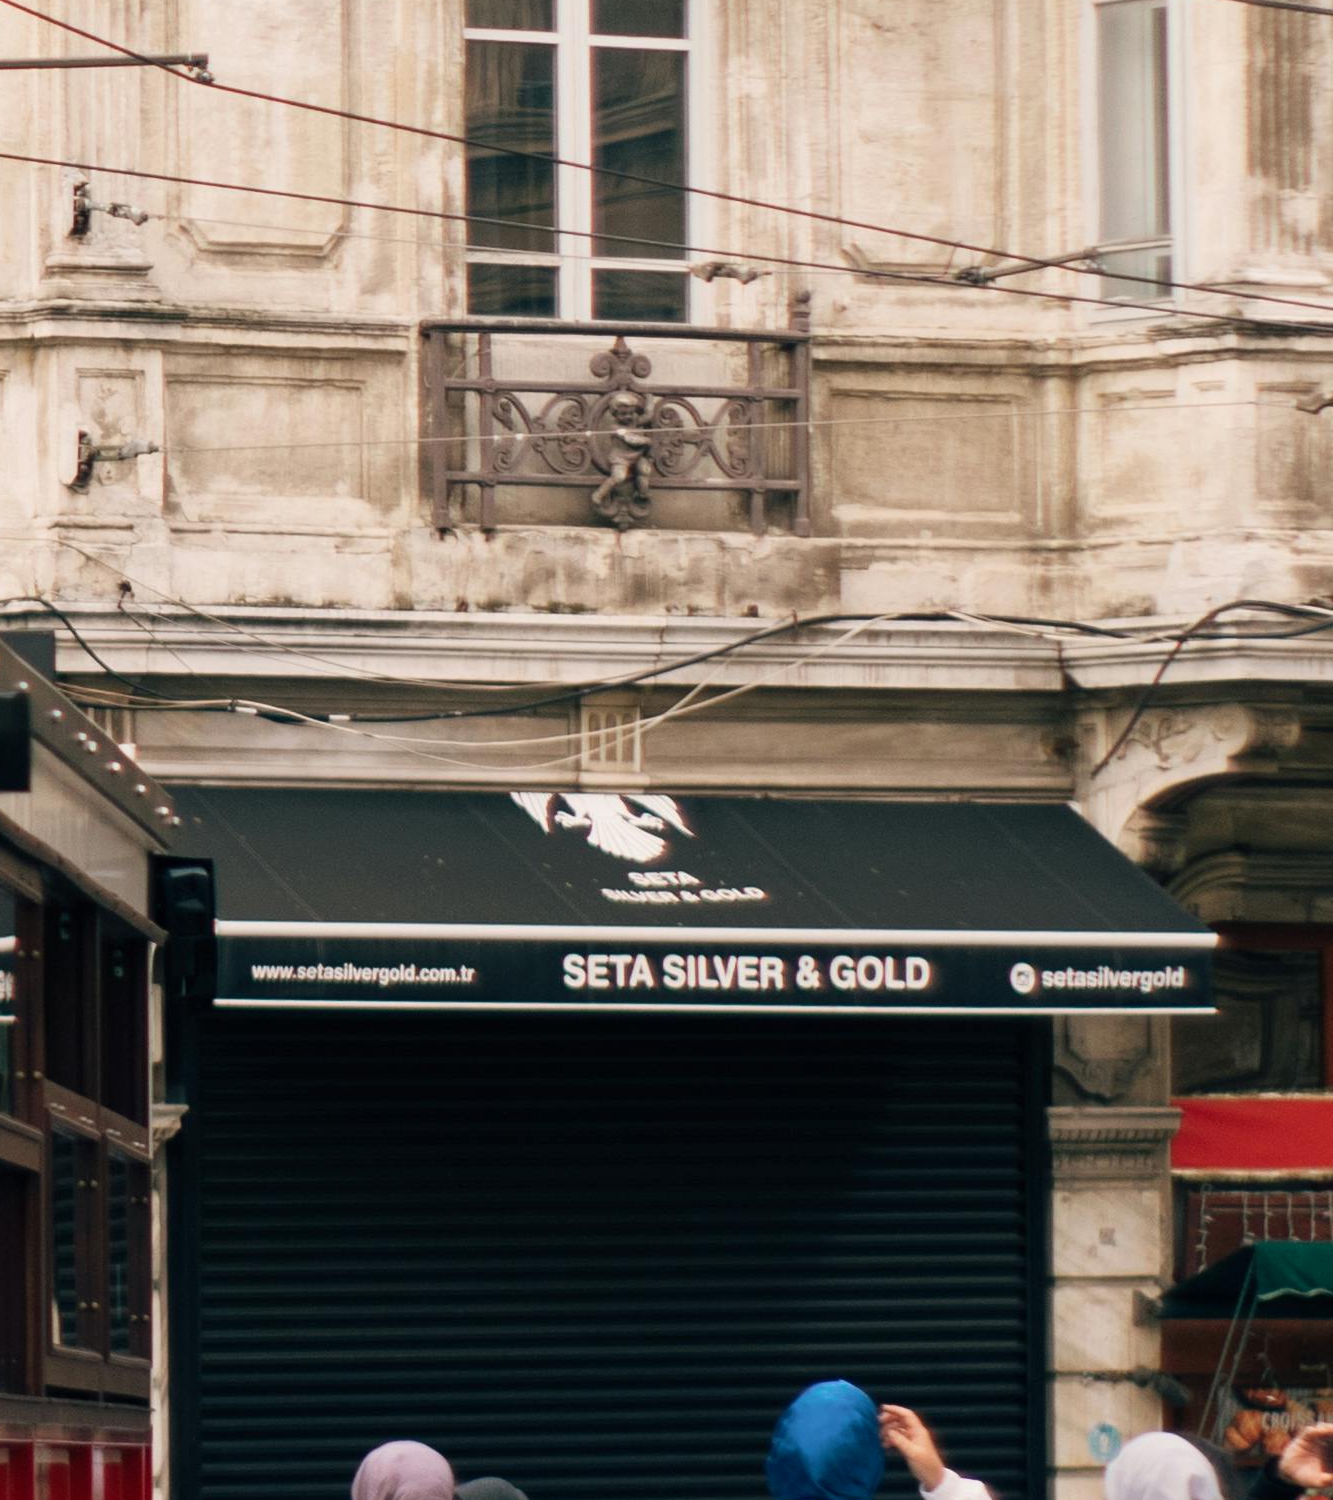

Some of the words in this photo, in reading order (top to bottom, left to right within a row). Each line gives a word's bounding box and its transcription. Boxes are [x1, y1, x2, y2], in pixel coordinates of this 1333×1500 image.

[628, 871, 702, 887] SETA
[700, 886, 767, 901] GOLD
[251, 963, 476, 986] www.setasilvergold.com.tr
[562, 953, 654, 989] SETA
[662, 954, 785, 990] SILVER
[795, 955, 822, 990] &
[829, 955, 932, 991] GOLD
[1041, 966, 1185, 994] setasilvergold
